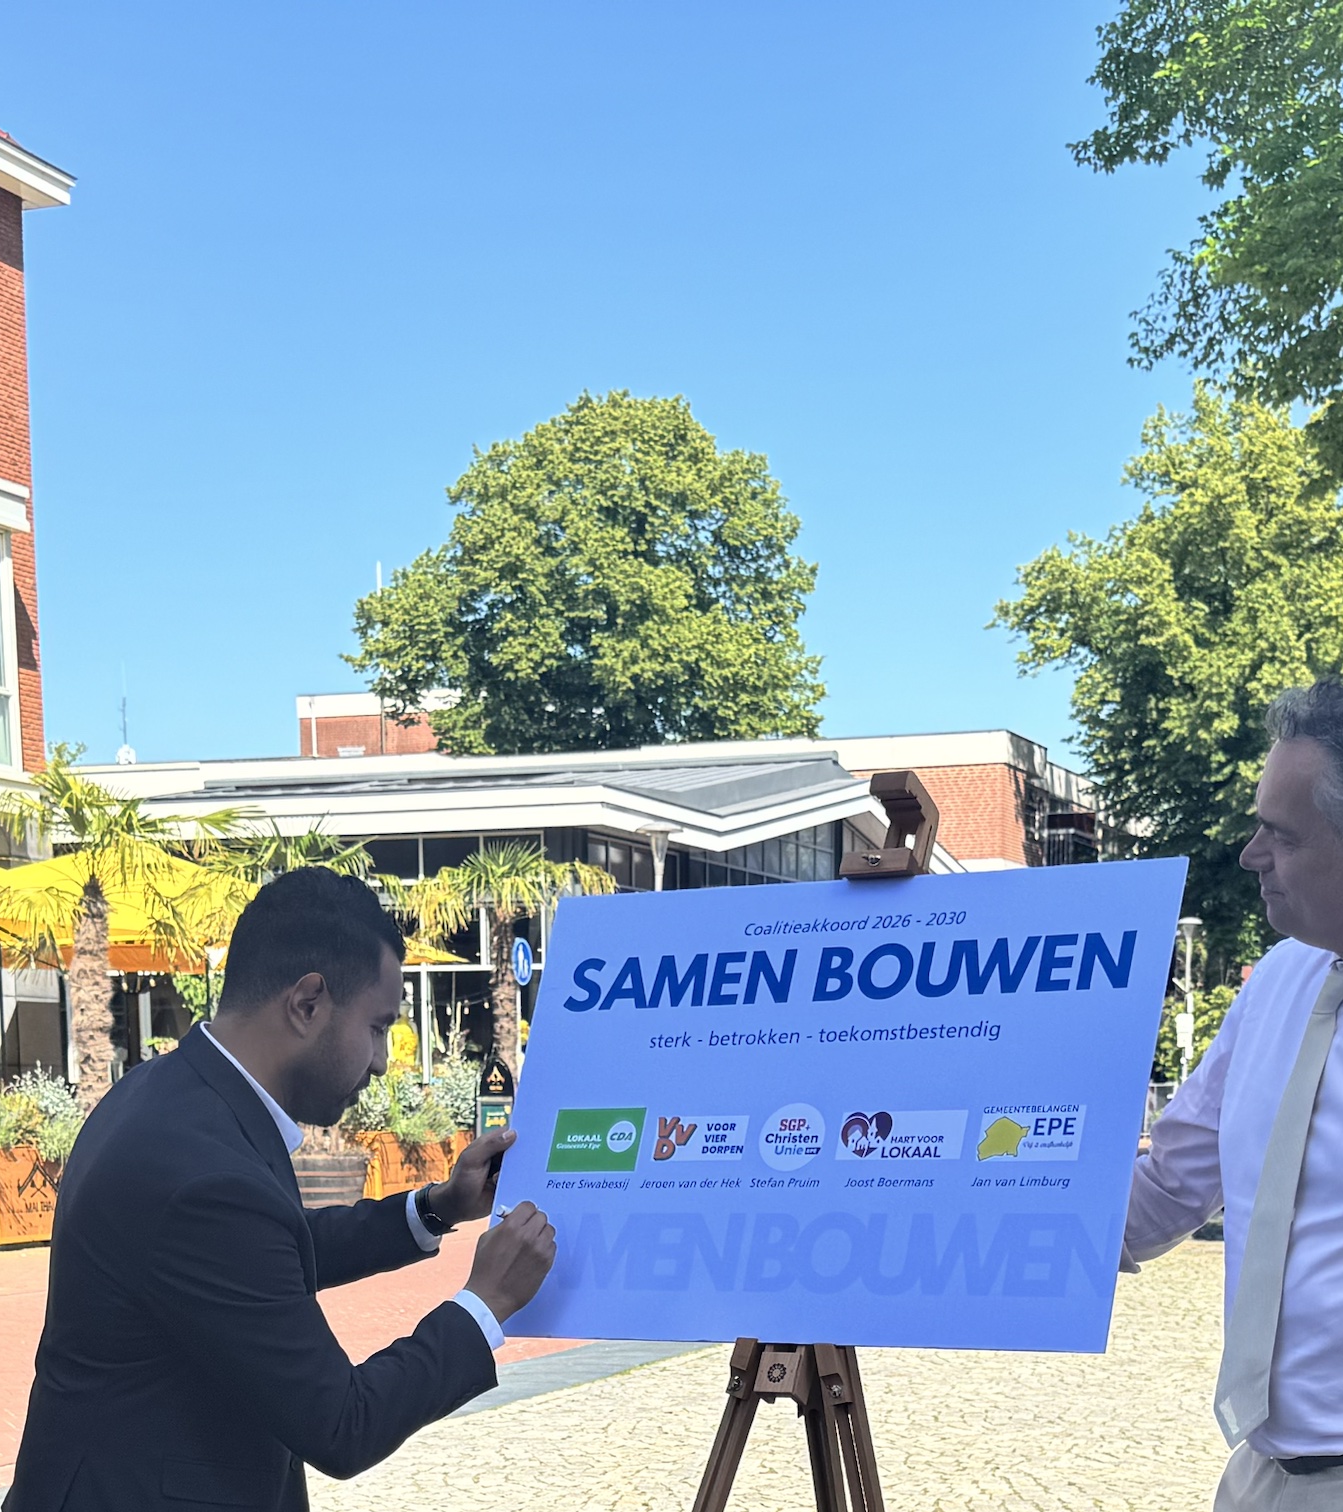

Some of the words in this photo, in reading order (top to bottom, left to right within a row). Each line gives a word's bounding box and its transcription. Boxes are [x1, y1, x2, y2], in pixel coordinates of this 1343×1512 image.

[744, 916, 870, 936] Coalitieakkoord
[872, 914, 912, 930] 2026
[925, 910, 967, 927] 2030
[563, 948, 798, 1013] SAMEN
[812, 930, 1138, 1002] BOUWEN
[649, 1031, 692, 1049] sterk
[708, 1028, 800, 1047] betrokken
[818, 1020, 1002, 1044] toekomstbestendig
[983, 1104, 1080, 1114] GEMEENTEBELANGEN
[706, 1123, 737, 1132] VOOR
[1032, 1117, 1077, 1136] EPE
[567, 1134, 602, 1142] LOKAAL
[610, 1132, 633, 1141] CDA
[704, 1134, 728, 1143] VIER
[765, 1132, 818, 1144] Christen
[891, 1135, 915, 1144] HART
[917, 1135, 945, 1144] VOOR
[701, 1145, 744, 1154] DORPEN
[774, 1144, 804, 1155] Unie
[881, 1146, 942, 1158] LOKAAL
[546, 1179, 575, 1189] Pieter
[577, 1178, 630, 1191] Siwabessij
[640, 1179, 675, 1190] Jeroen
[678, 1181, 697, 1189] van
[699, 1178, 719, 1188] der
[720, 1178, 742, 1188] Hek
[749, 1177, 784, 1188] Stefan
[787, 1177, 820, 1188] Pruim
[844, 1177, 875, 1188] Joost
[877, 1177, 935, 1188] Boermans
[971, 1176, 992, 1188] Jan
[995, 1178, 1016, 1187] van
[1019, 1176, 1070, 1189] Limburg
